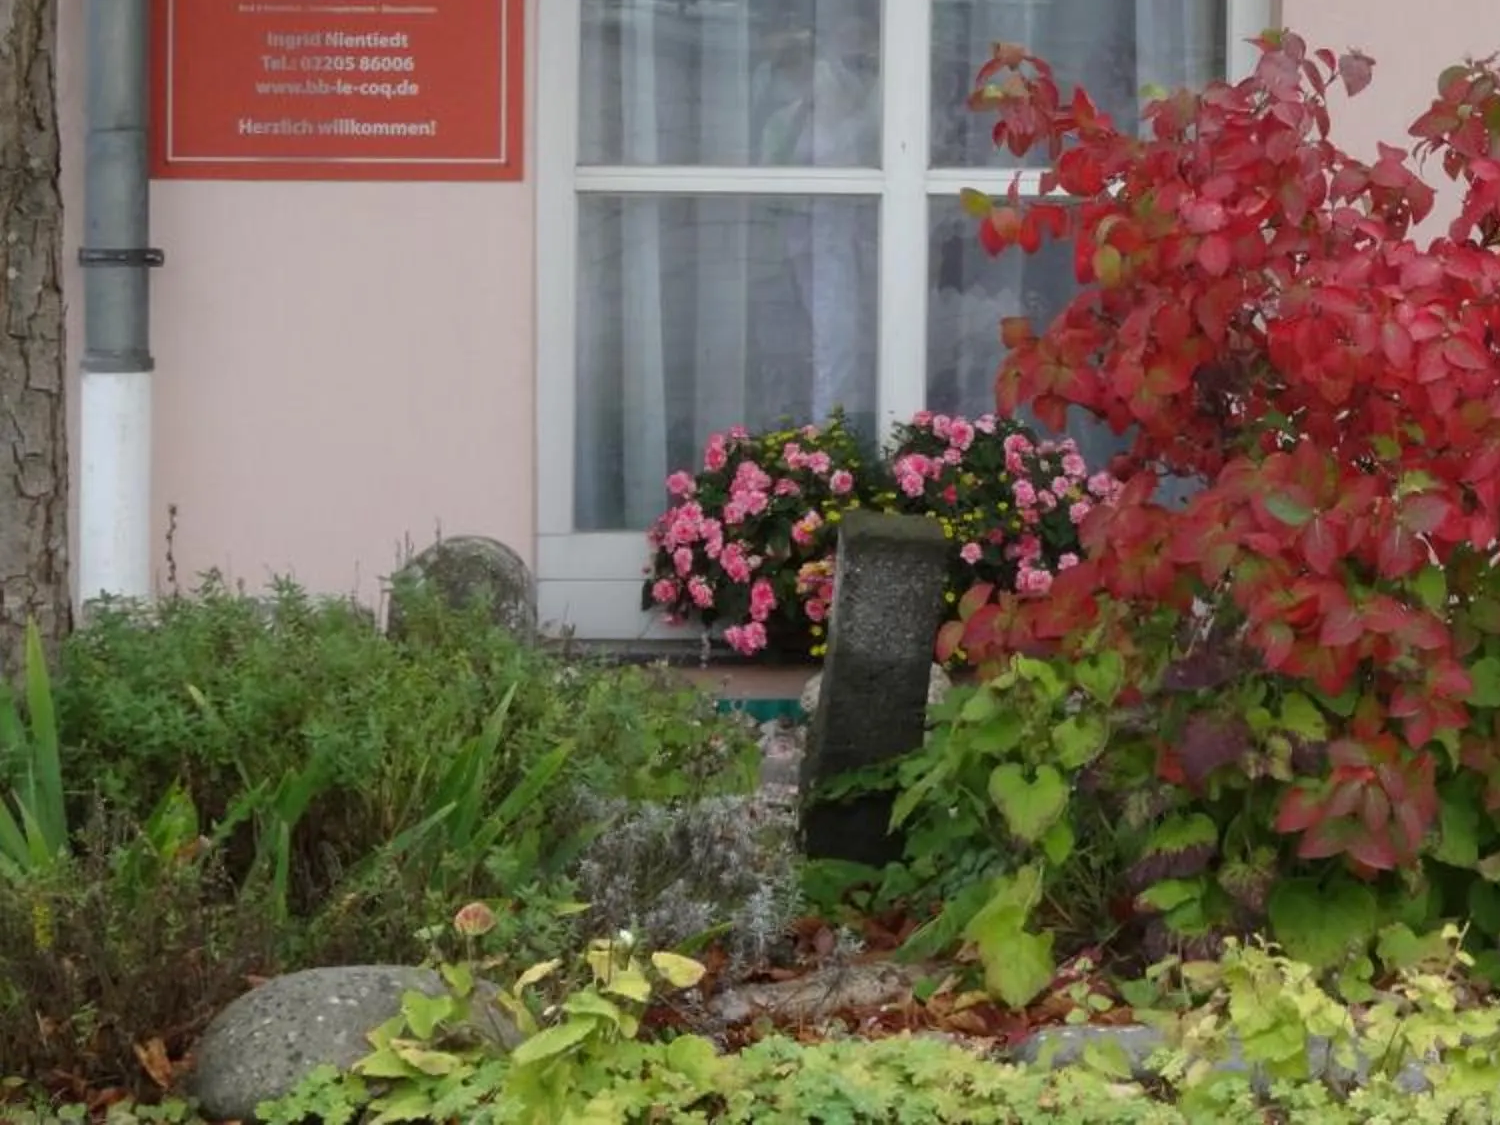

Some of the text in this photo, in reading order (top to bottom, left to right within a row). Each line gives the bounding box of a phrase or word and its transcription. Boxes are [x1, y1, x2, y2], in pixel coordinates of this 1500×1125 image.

[266, 31, 322, 50] Ingrid
[262, 55, 415, 72] Tel.: 02205 86006
[255, 79, 419, 99] www.bb-le-coq.de
[238, 119, 437, 136] Herzlich willkommen!
